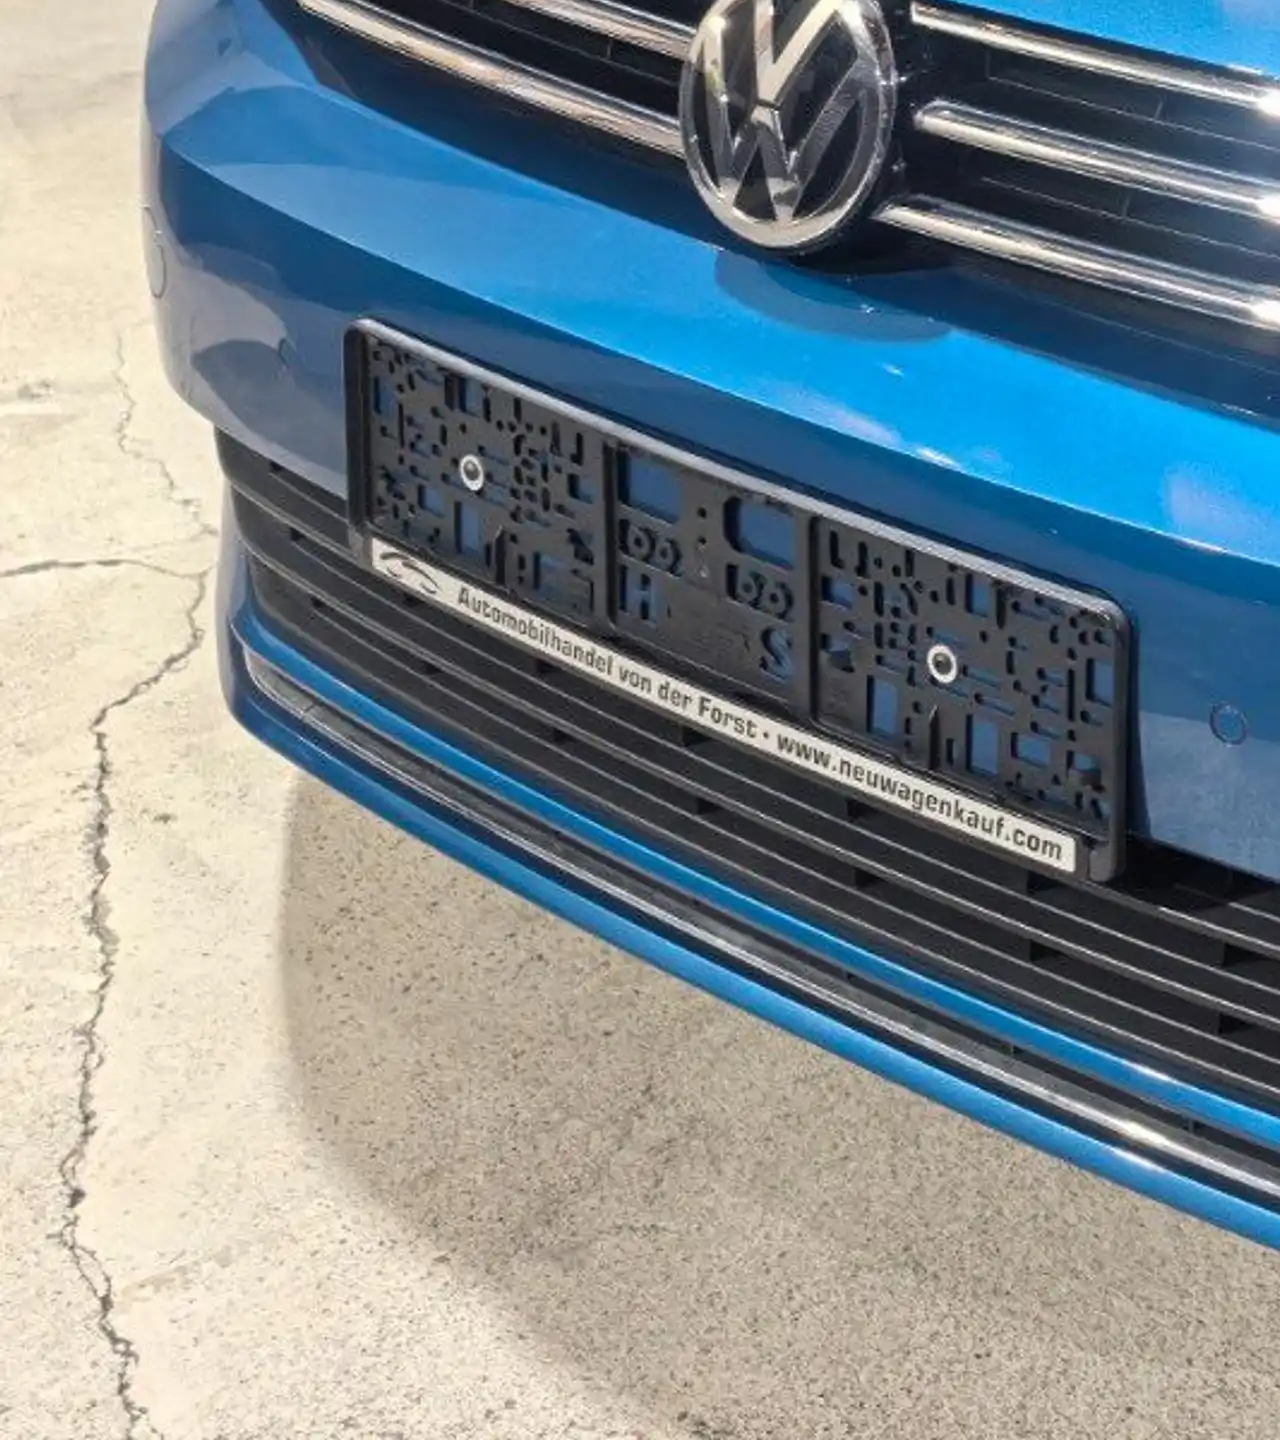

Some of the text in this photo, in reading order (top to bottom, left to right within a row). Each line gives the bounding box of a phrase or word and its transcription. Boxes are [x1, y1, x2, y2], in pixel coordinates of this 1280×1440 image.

[457, 586, 1063, 861] Automobilhandel von der Forst www.neuwagenkauf.com
